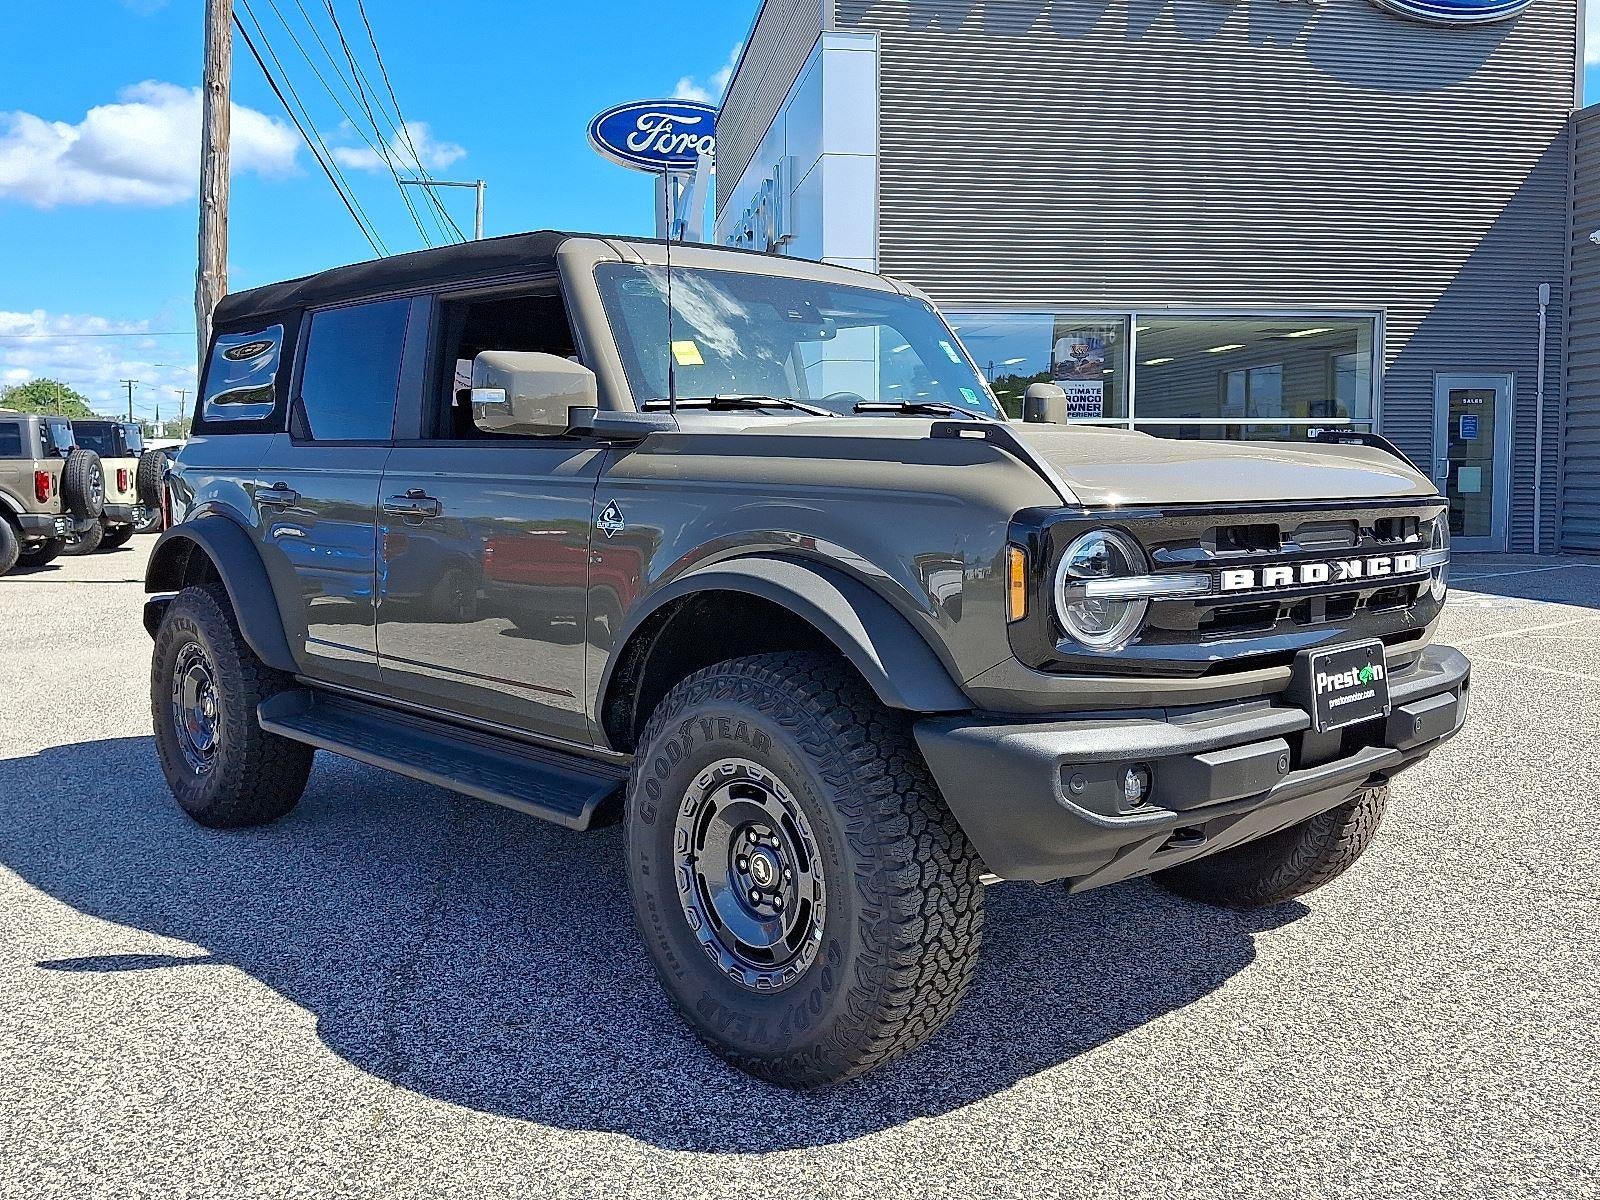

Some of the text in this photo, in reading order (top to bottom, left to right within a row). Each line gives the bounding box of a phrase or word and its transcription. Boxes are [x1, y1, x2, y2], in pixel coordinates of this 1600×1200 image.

[1066, 395, 1102, 403] RONCO
[1067, 403, 1102, 412] WNER
[1220, 554, 1417, 591] BRONCO
[1316, 662, 1384, 695] Preston
[1328, 688, 1376, 710] prestonmotor.com
[639, 715, 772, 826] GOODYEAR
